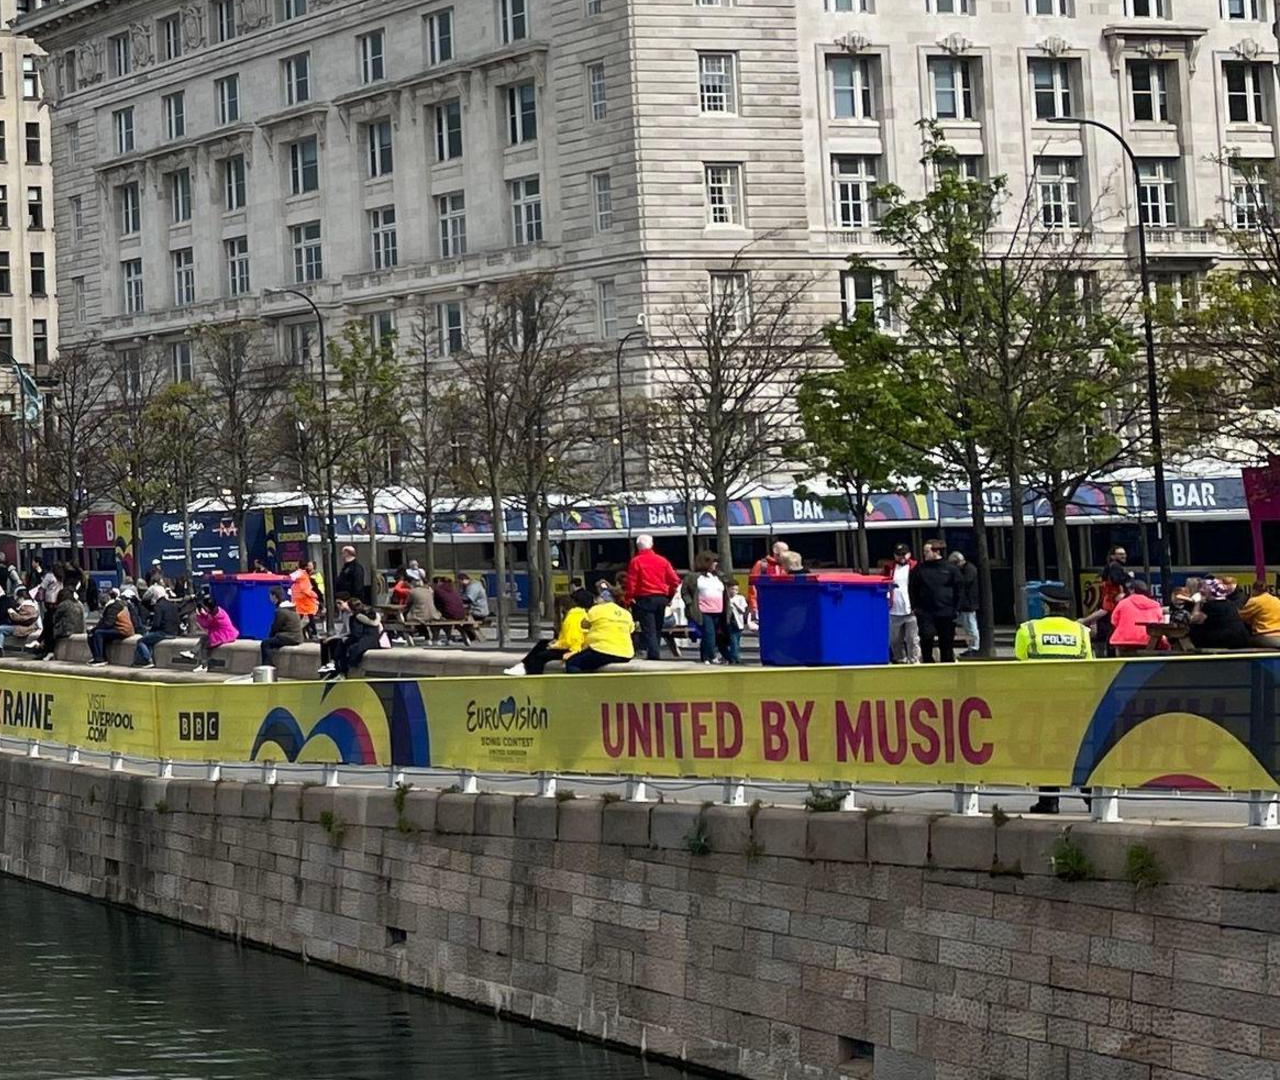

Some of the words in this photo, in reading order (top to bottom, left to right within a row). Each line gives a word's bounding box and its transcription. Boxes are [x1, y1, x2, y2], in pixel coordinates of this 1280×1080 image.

[1171, 483, 1216, 507] BAR
[648, 505, 675, 525] BAR
[793, 500, 824, 520] BAR
[1043, 635, 1077, 645] POLICE
[87, 693, 106, 709] VISIT
[87, 711, 134, 730] LIVERPOOL
[180, 714, 217, 738] BBC
[86, 728, 107, 742] .COM
[601, 701, 744, 759] UNITED
[760, 700, 816, 762] BY
[838, 696, 994, 766] MUSIC
[481, 737, 501, 746] SONG
[503, 737, 534, 747] CONTEST
